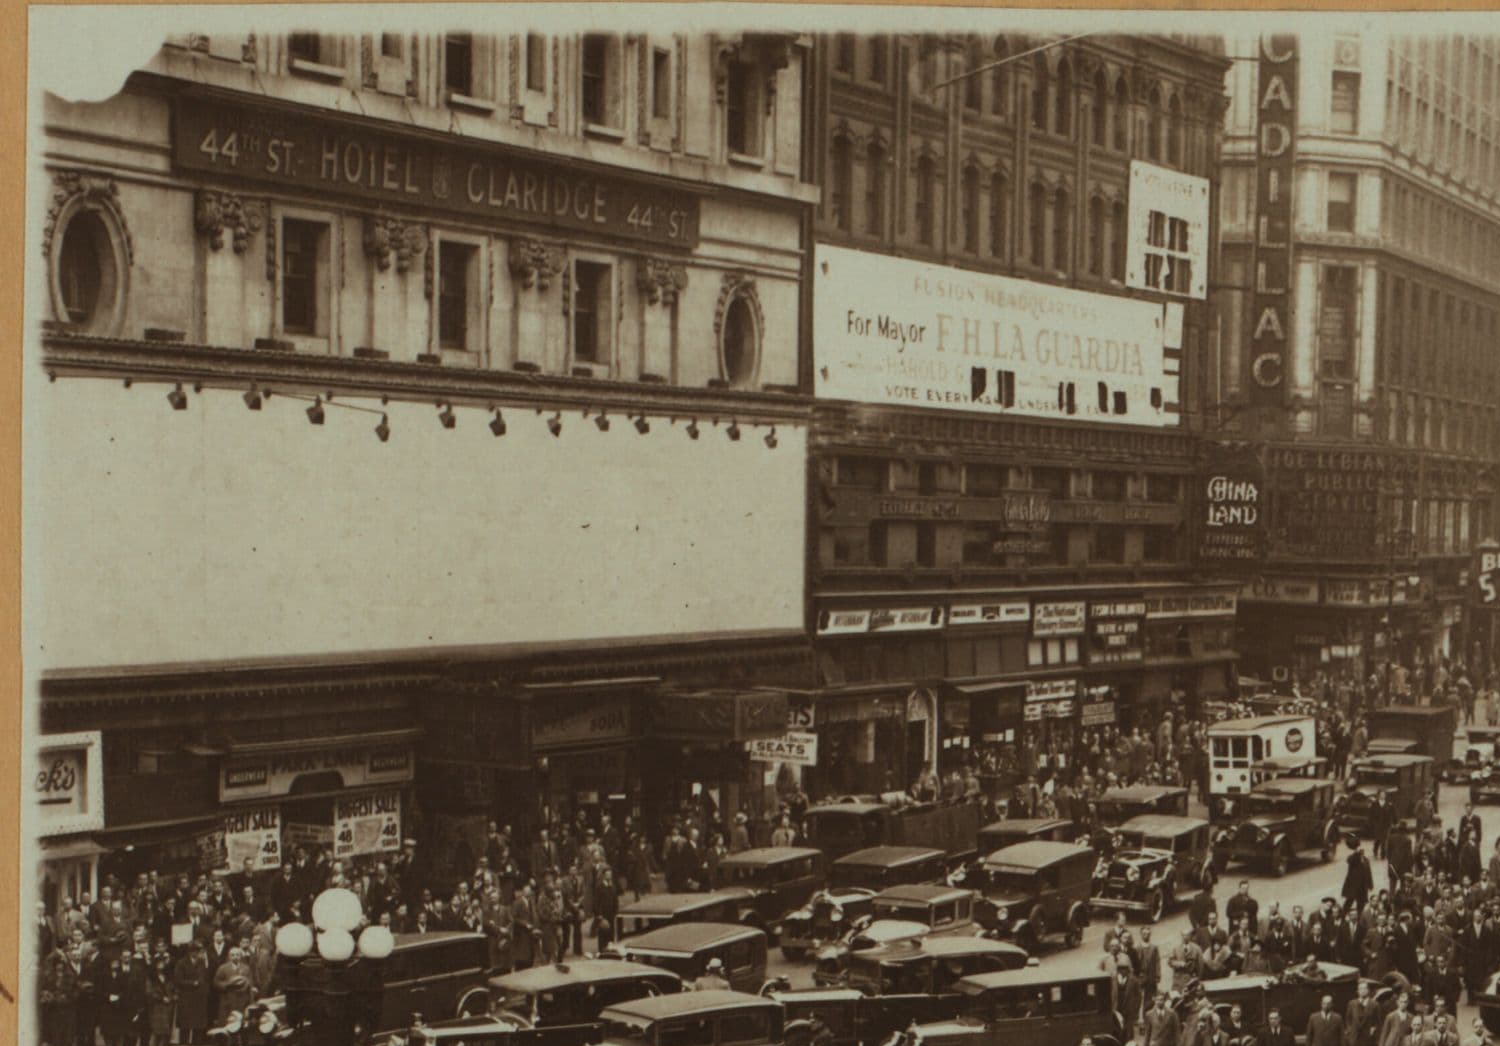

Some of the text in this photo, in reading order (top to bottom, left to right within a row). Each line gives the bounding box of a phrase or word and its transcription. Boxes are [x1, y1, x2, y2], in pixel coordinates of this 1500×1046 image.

[320, 135, 419, 194] HOTEL
[467, 163, 607, 224] CLARIDGE
[847, 310, 871, 336] For
[877, 315, 927, 352] Mayor
[885, 385, 919, 399] VOTE
[927, 389, 970, 403] EVERY
[1207, 476, 1258, 502] CHINA
[1207, 504, 1257, 526] LAND
[756, 741, 805, 755] SEATS
[376, 791, 398, 813] SALE
[251, 807, 278, 830] SALE
[338, 829, 353, 843] 48
[382, 824, 397, 836] 48
[262, 841, 278, 854] 48
